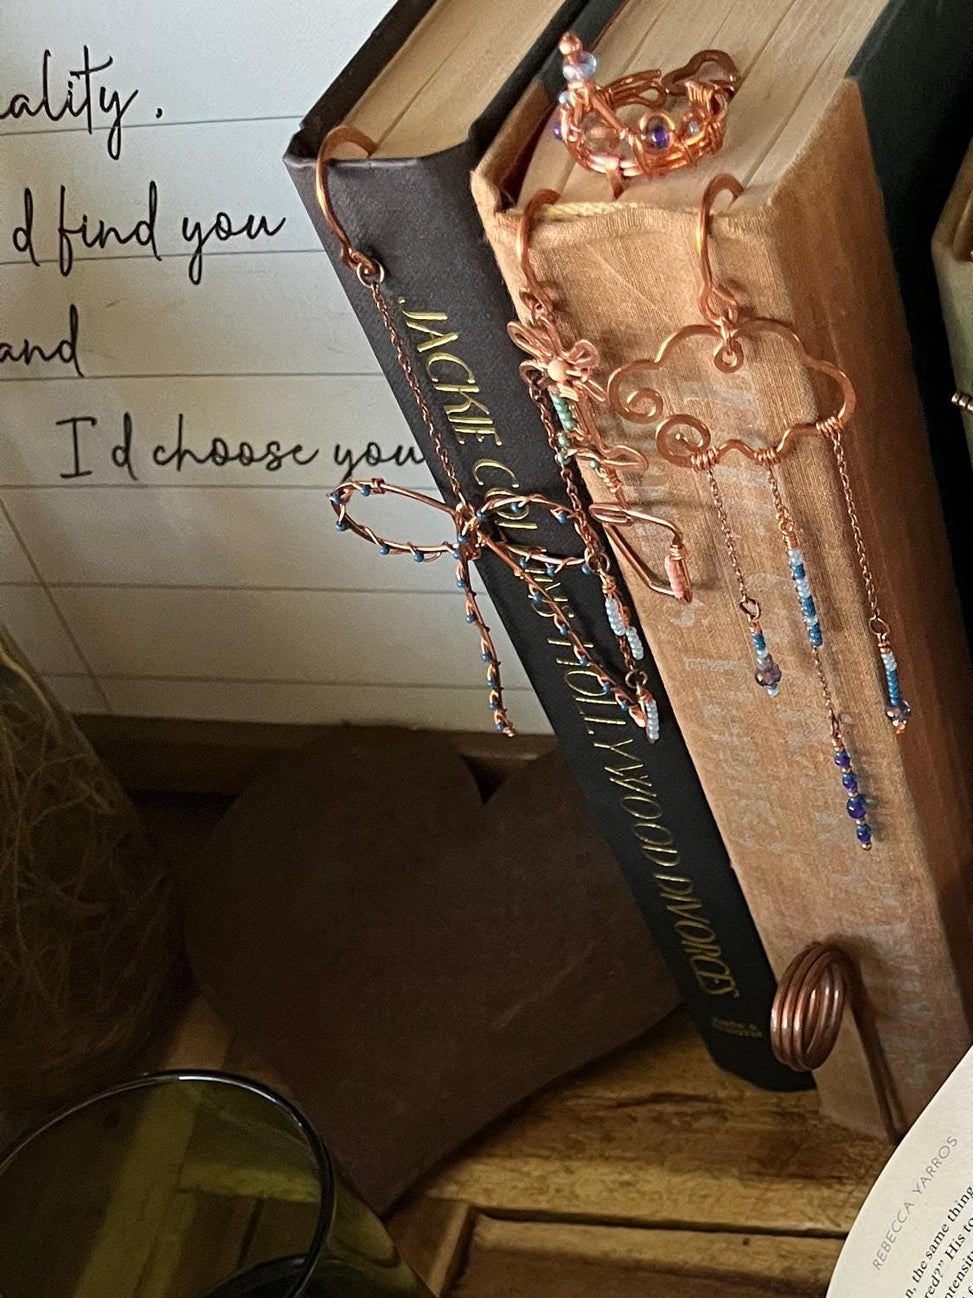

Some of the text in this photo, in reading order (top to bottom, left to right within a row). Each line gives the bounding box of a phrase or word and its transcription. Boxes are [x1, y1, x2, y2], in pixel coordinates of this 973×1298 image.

[57, 180, 163, 277] find
[181, 211, 287, 284] you
[152, 413, 320, 473] choose
[333, 441, 426, 484] you
[396, 295, 503, 447] JACKIE
[546, 636, 682, 867] HOLLYWOOD
[652, 873, 741, 999] DIVORCES
[871, 1134, 958, 1271] REBECCA YARROS
